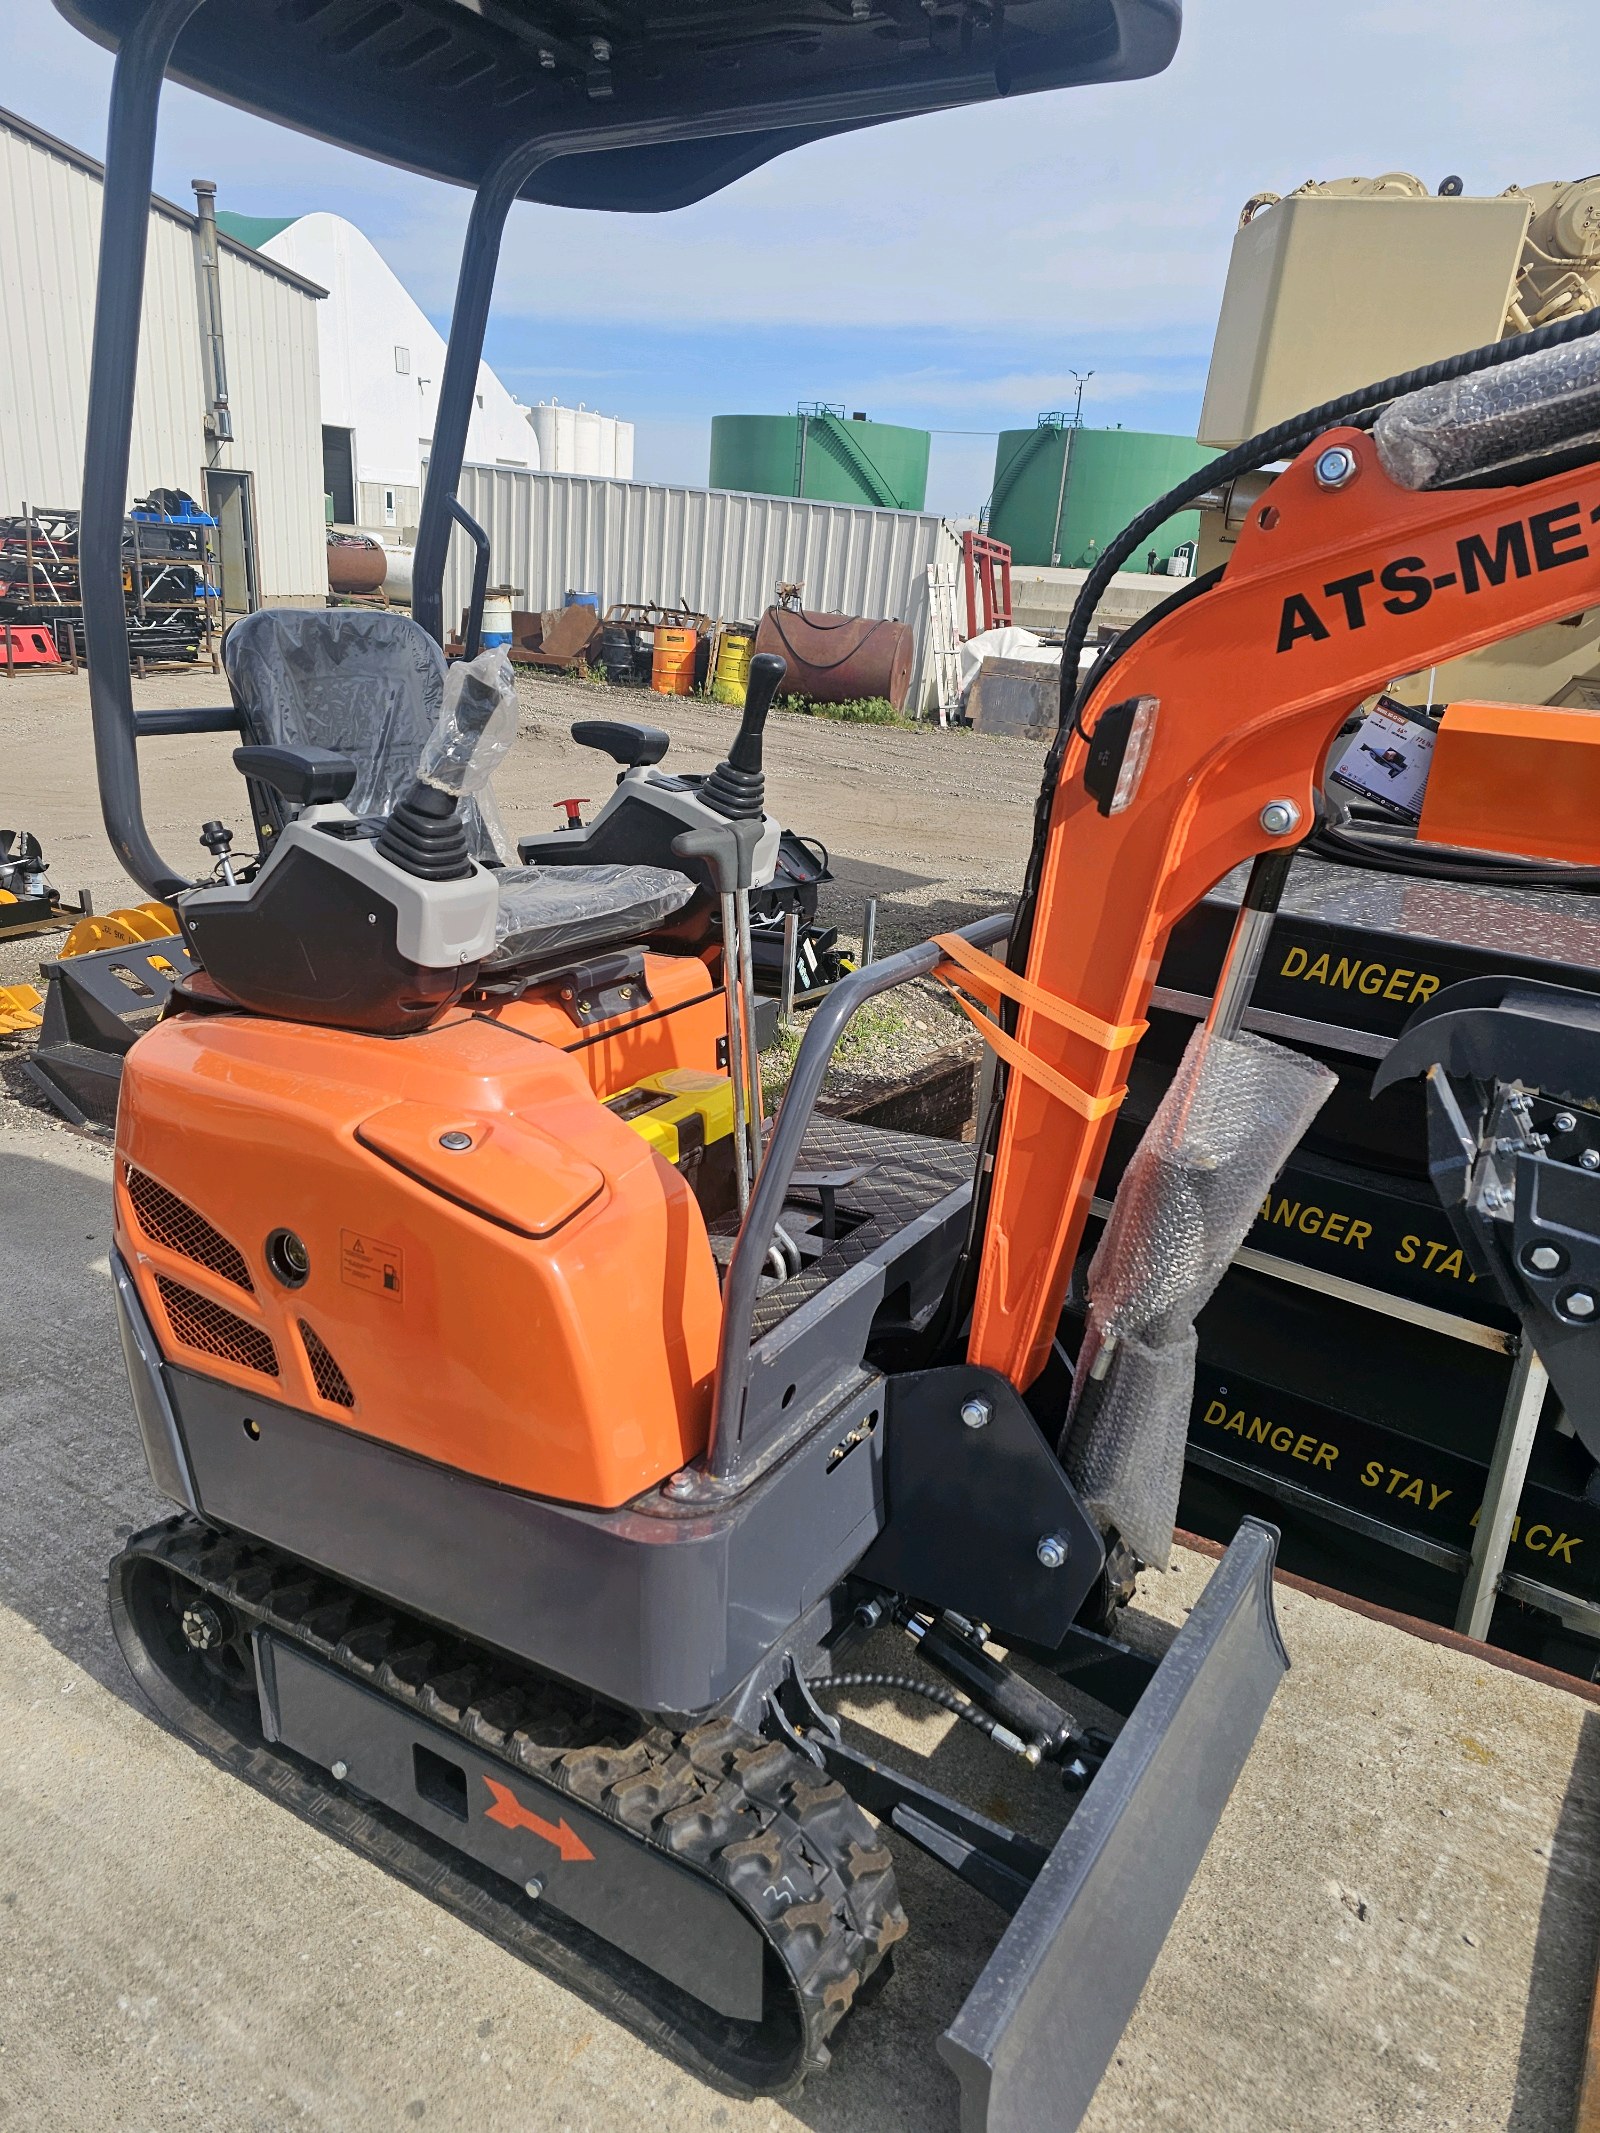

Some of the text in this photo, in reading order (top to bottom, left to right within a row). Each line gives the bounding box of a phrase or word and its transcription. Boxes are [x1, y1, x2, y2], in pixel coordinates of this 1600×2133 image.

[1277, 501, 1600, 654] ATS-ME
[1280, 946, 1440, 1004] DANGER
[1394, 1234, 1478, 1284] STA
[1203, 1400, 1341, 1472] DANGER
[1360, 1460, 1453, 1511] STAY
